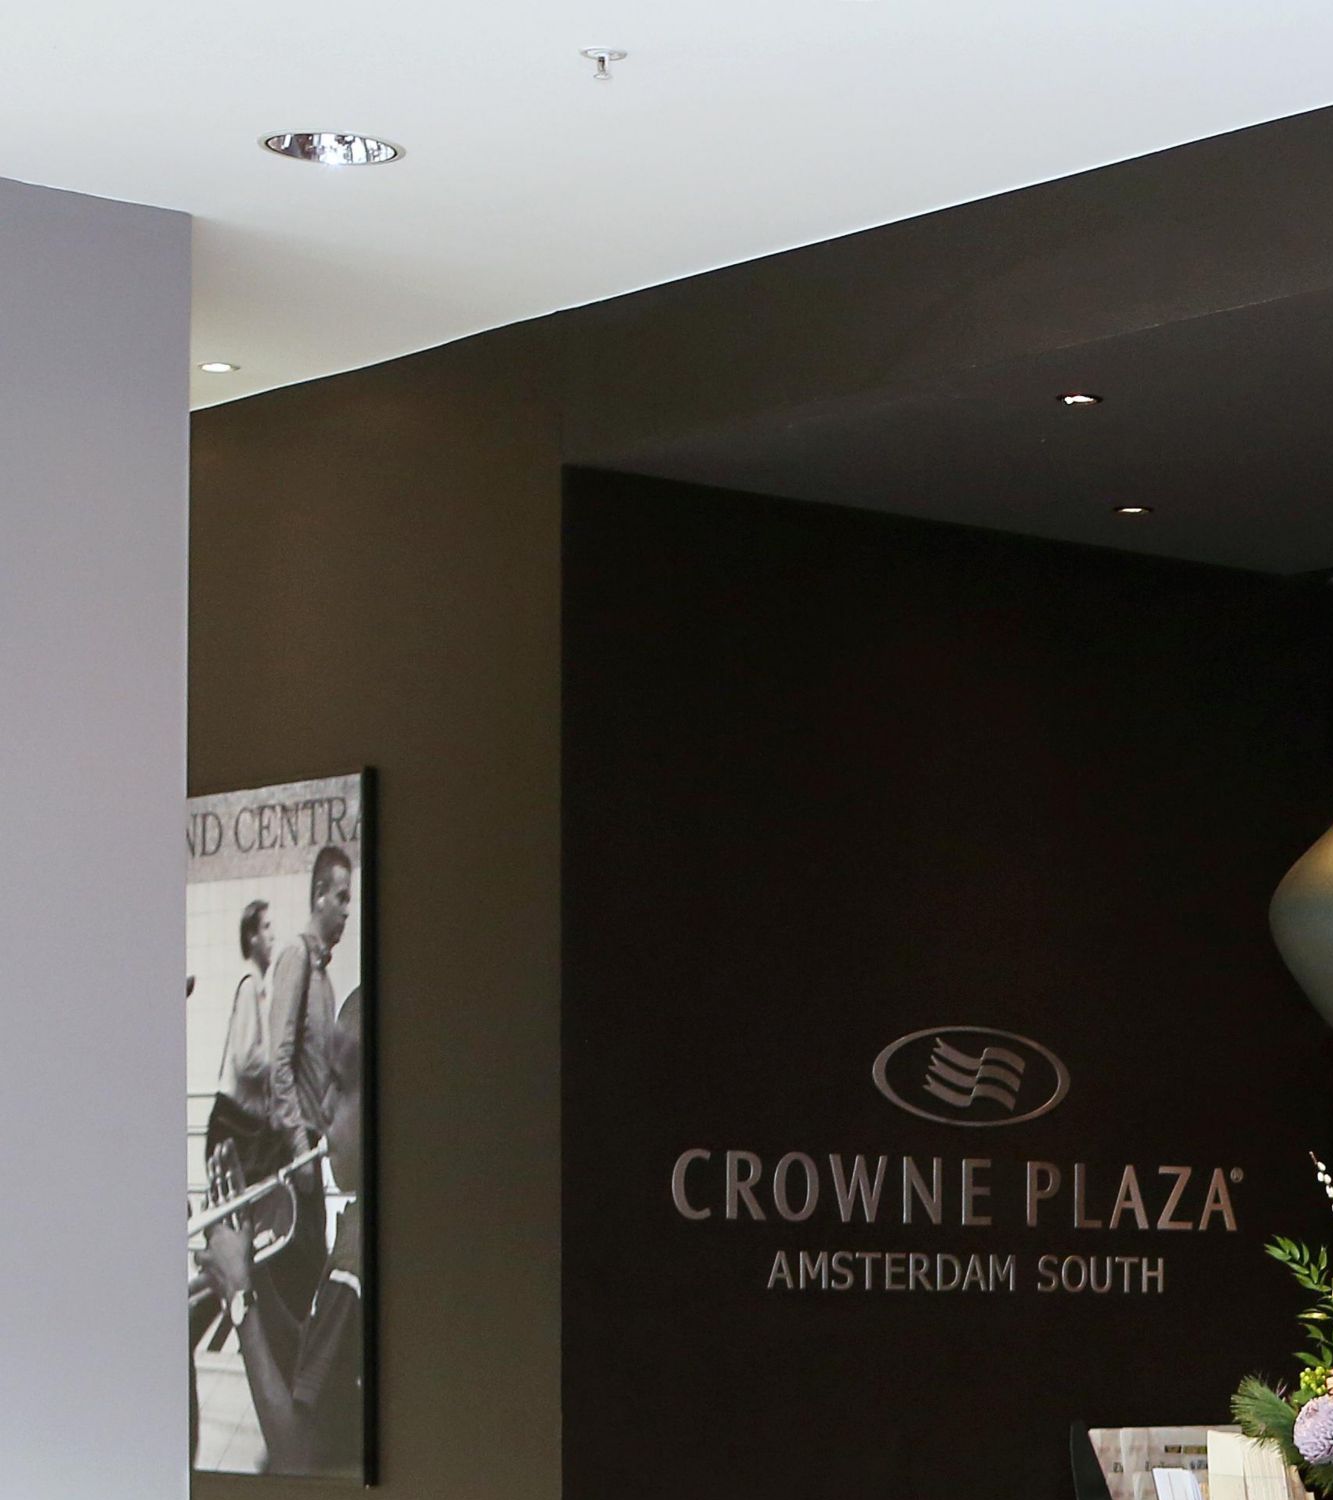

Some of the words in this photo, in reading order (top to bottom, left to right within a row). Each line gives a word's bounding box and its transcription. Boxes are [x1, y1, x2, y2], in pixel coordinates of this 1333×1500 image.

[671, 1148, 992, 1227] CROWNE
[767, 1250, 1016, 1293] AMSTERDAM
[1037, 1255, 1164, 1294] SOUTH
